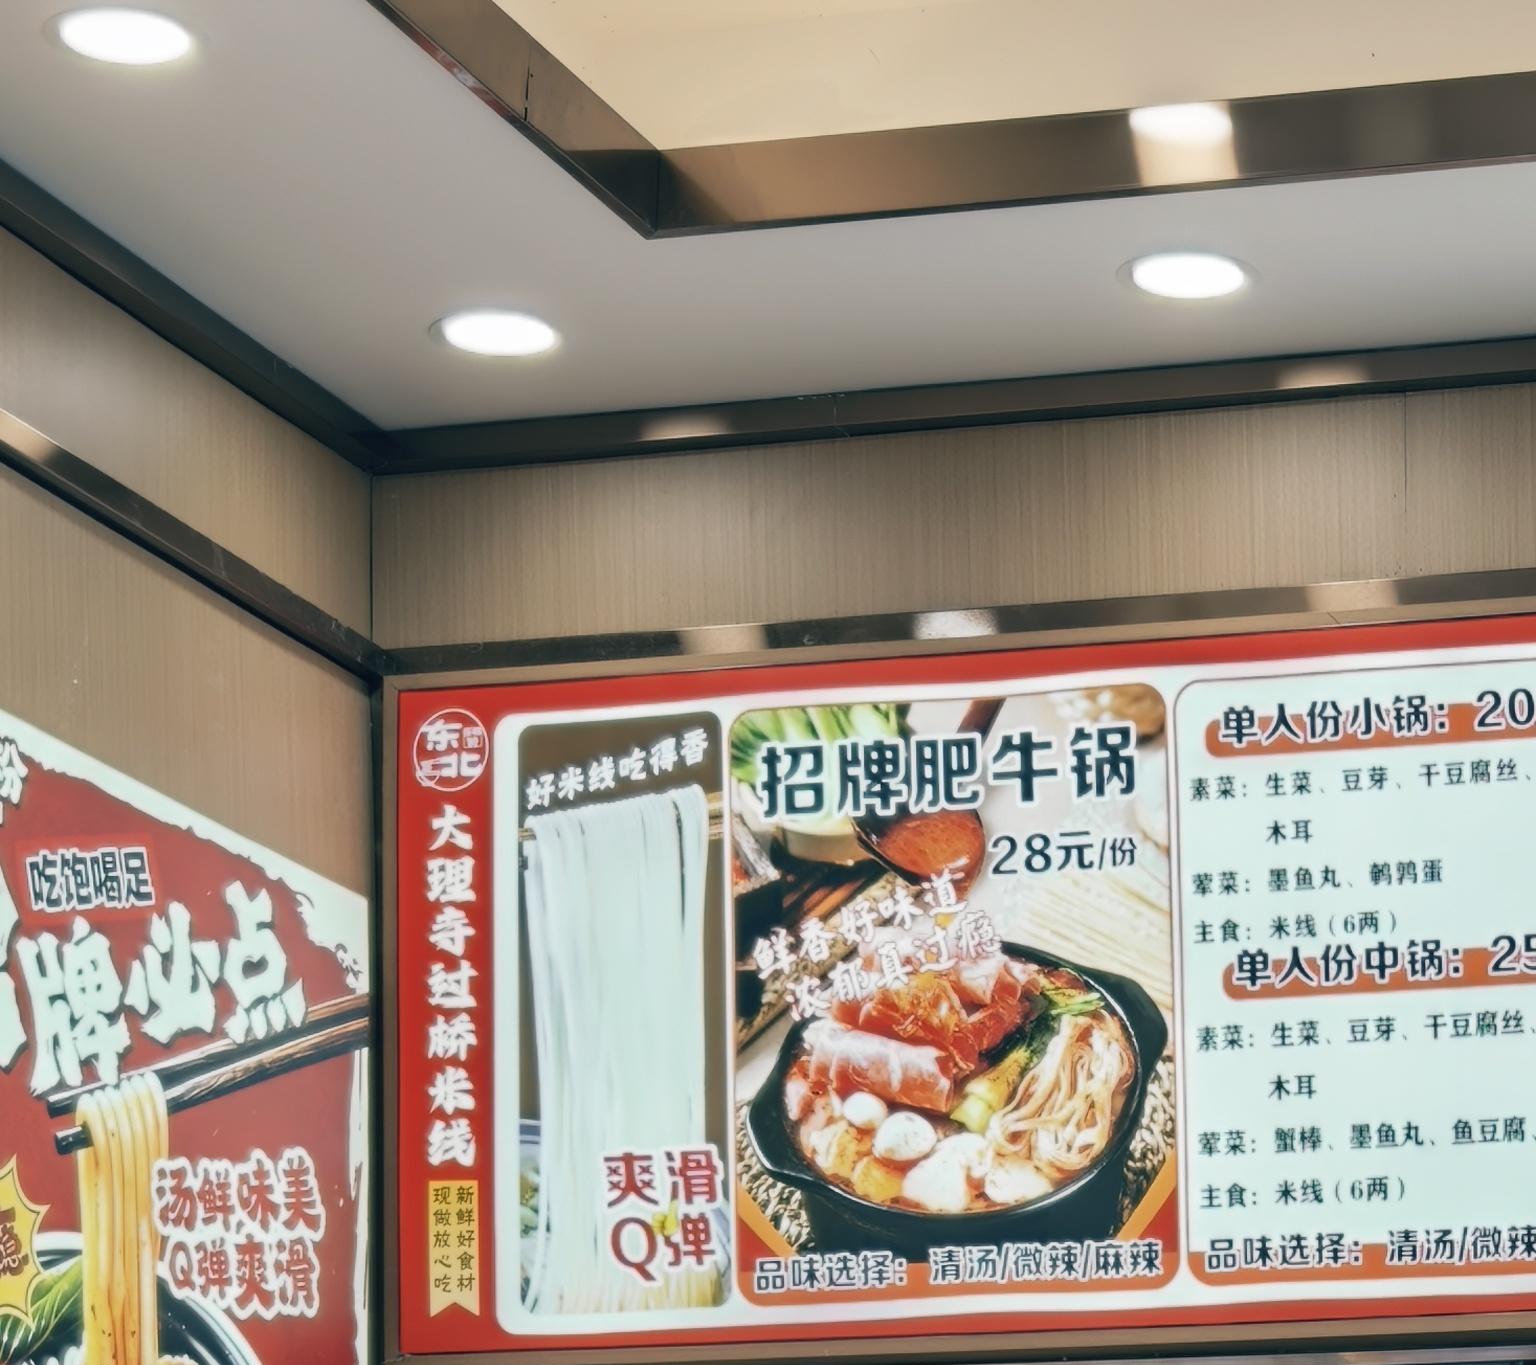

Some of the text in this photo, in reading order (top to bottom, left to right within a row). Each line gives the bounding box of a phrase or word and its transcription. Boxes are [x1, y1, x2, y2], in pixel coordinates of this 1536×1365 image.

[526, 728, 709, 809] 好米线吃得香
[760, 726, 1137, 817] 招牌肥牛锅
[990, 831, 1137, 874] 28元/份
[1266, 819, 1313, 845] 木耳
[26, 848, 153, 909] 吃饱喝足
[754, 865, 968, 979] 鲜香好味道
[0, 880, 305, 1095] 牌必点
[426, 804, 479, 1167] 大理寺过桥米线
[785, 911, 1001, 1021] 浓郁真过瘾
[1269, 1075, 1317, 1100] 木耳
[156, 1152, 323, 1236] 汤鲜味美
[604, 1151, 717, 1208] 爽滑
[168, 1236, 316, 1308] Q弹爽滑
[433, 1187, 451, 1293] 现做放心吃
[456, 1185, 475, 1291] 新鲜好食材
[611, 1213, 714, 1281] Q弹
